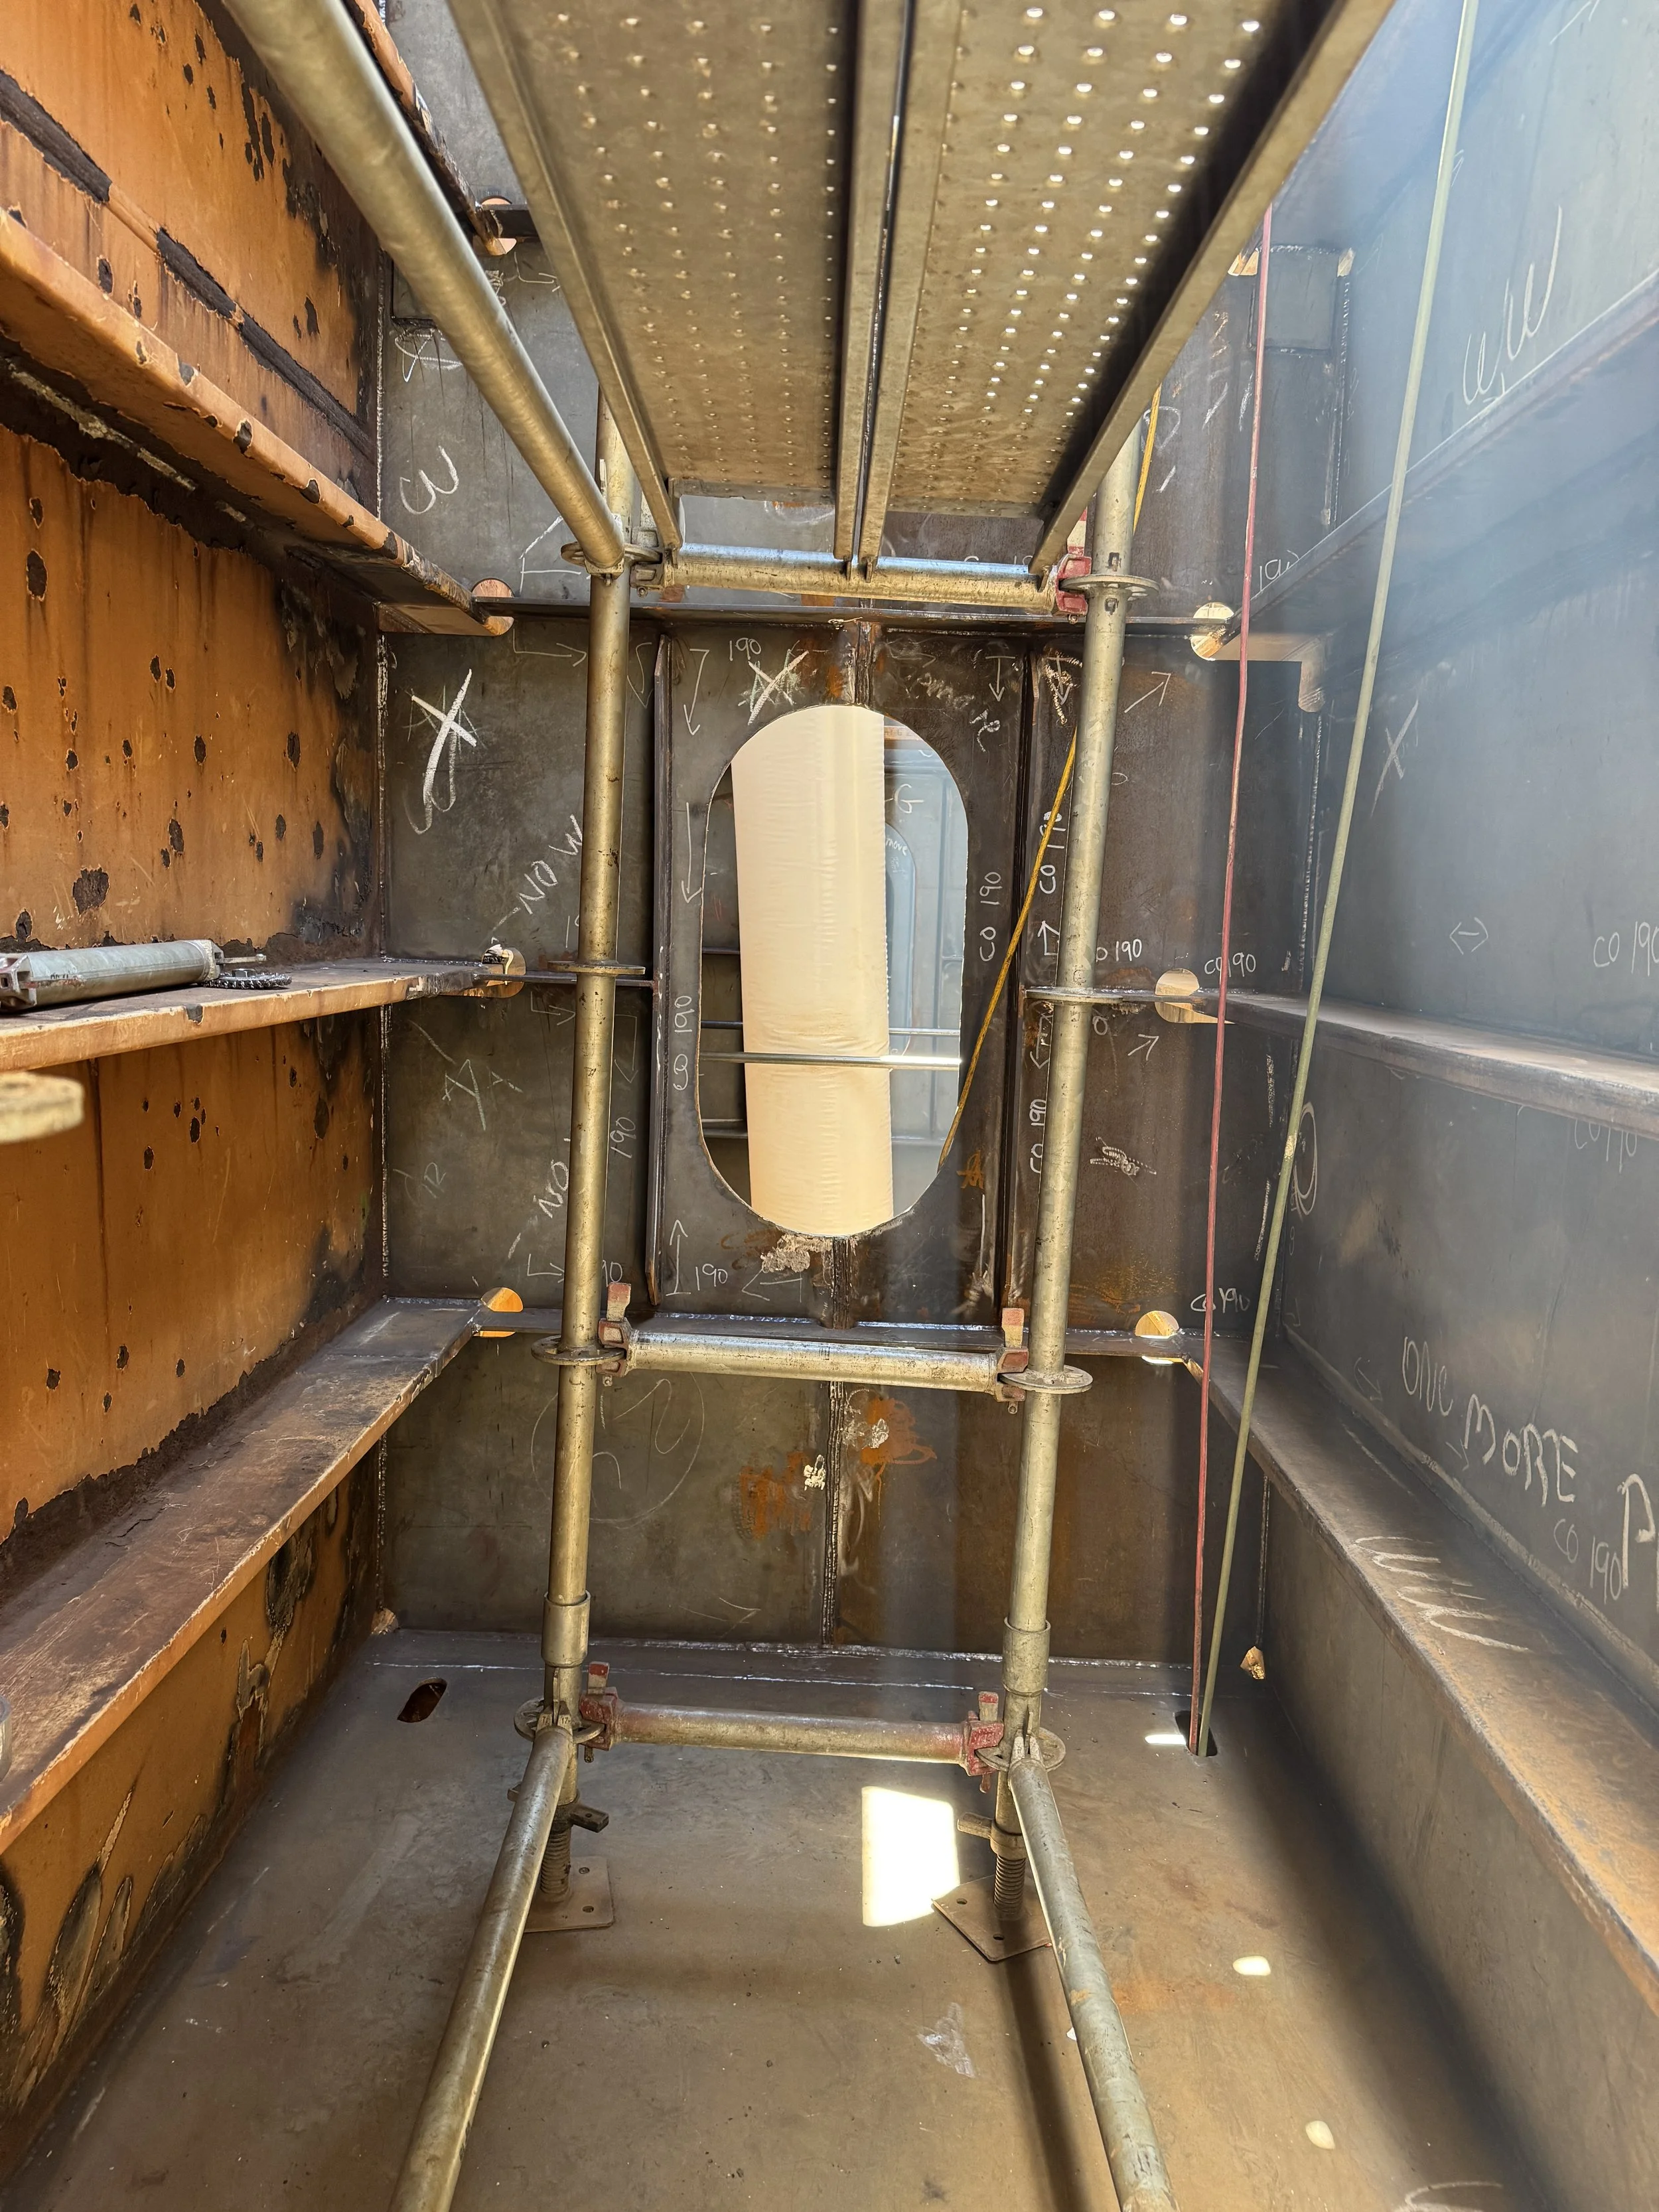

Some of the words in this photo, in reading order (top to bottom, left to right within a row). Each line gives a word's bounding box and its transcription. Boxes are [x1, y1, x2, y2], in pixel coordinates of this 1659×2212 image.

[729, 637, 762, 662] 190
[979, 871, 1003, 905] 190
[1115, 938, 1143, 962] 190
[674, 995, 695, 1033] 190
[610, 1116, 636, 1159] 190
[695, 1263, 728, 1291] 190
[1218, 1288, 1251, 1313] 190
[1617, 1473, 1659, 1615] P
[1589, 1535, 1623, 1605] 190
